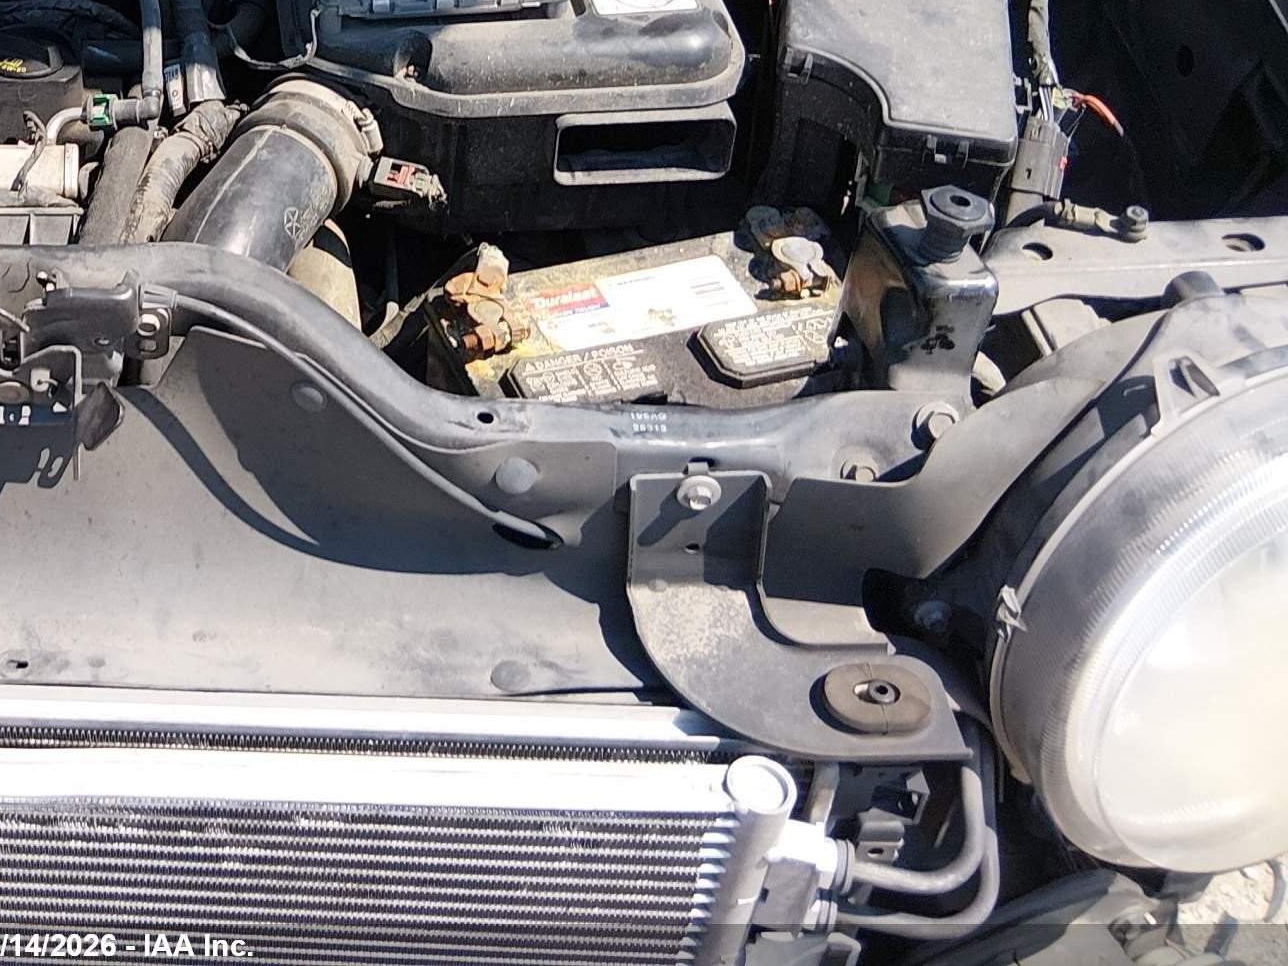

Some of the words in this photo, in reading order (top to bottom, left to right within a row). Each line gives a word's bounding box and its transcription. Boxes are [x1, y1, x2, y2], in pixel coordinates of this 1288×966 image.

[531, 287, 599, 308] Duralast
[535, 353, 582, 371] DANGER
[591, 344, 634, 359] POISON
